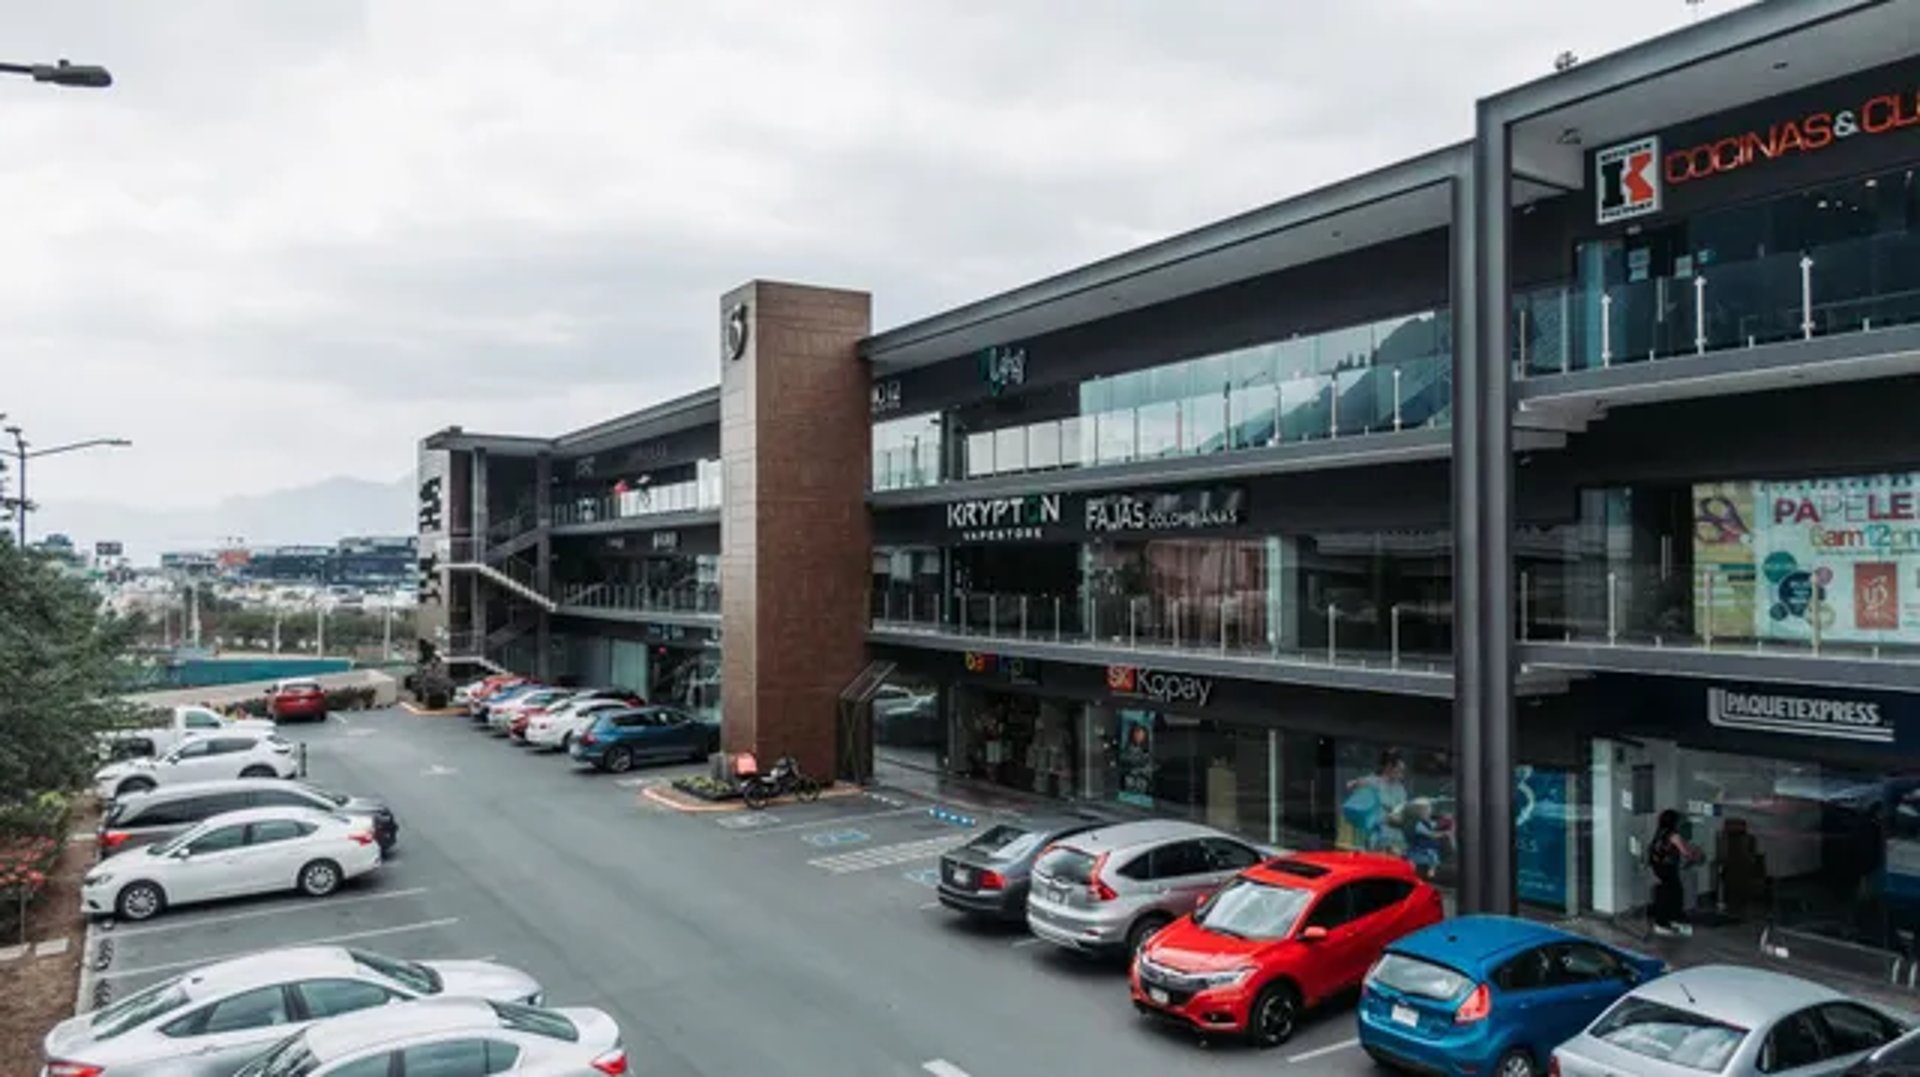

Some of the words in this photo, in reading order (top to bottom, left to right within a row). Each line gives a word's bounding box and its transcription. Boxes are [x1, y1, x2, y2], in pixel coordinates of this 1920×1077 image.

[947, 494, 1060, 529] KRYPTON
[1085, 496, 1145, 531] FAJAS
[1774, 491, 1920, 524] PAPELE
[1137, 664, 1213, 707] Kopay
[1727, 691, 1881, 725] PAQUETEXPRESS
